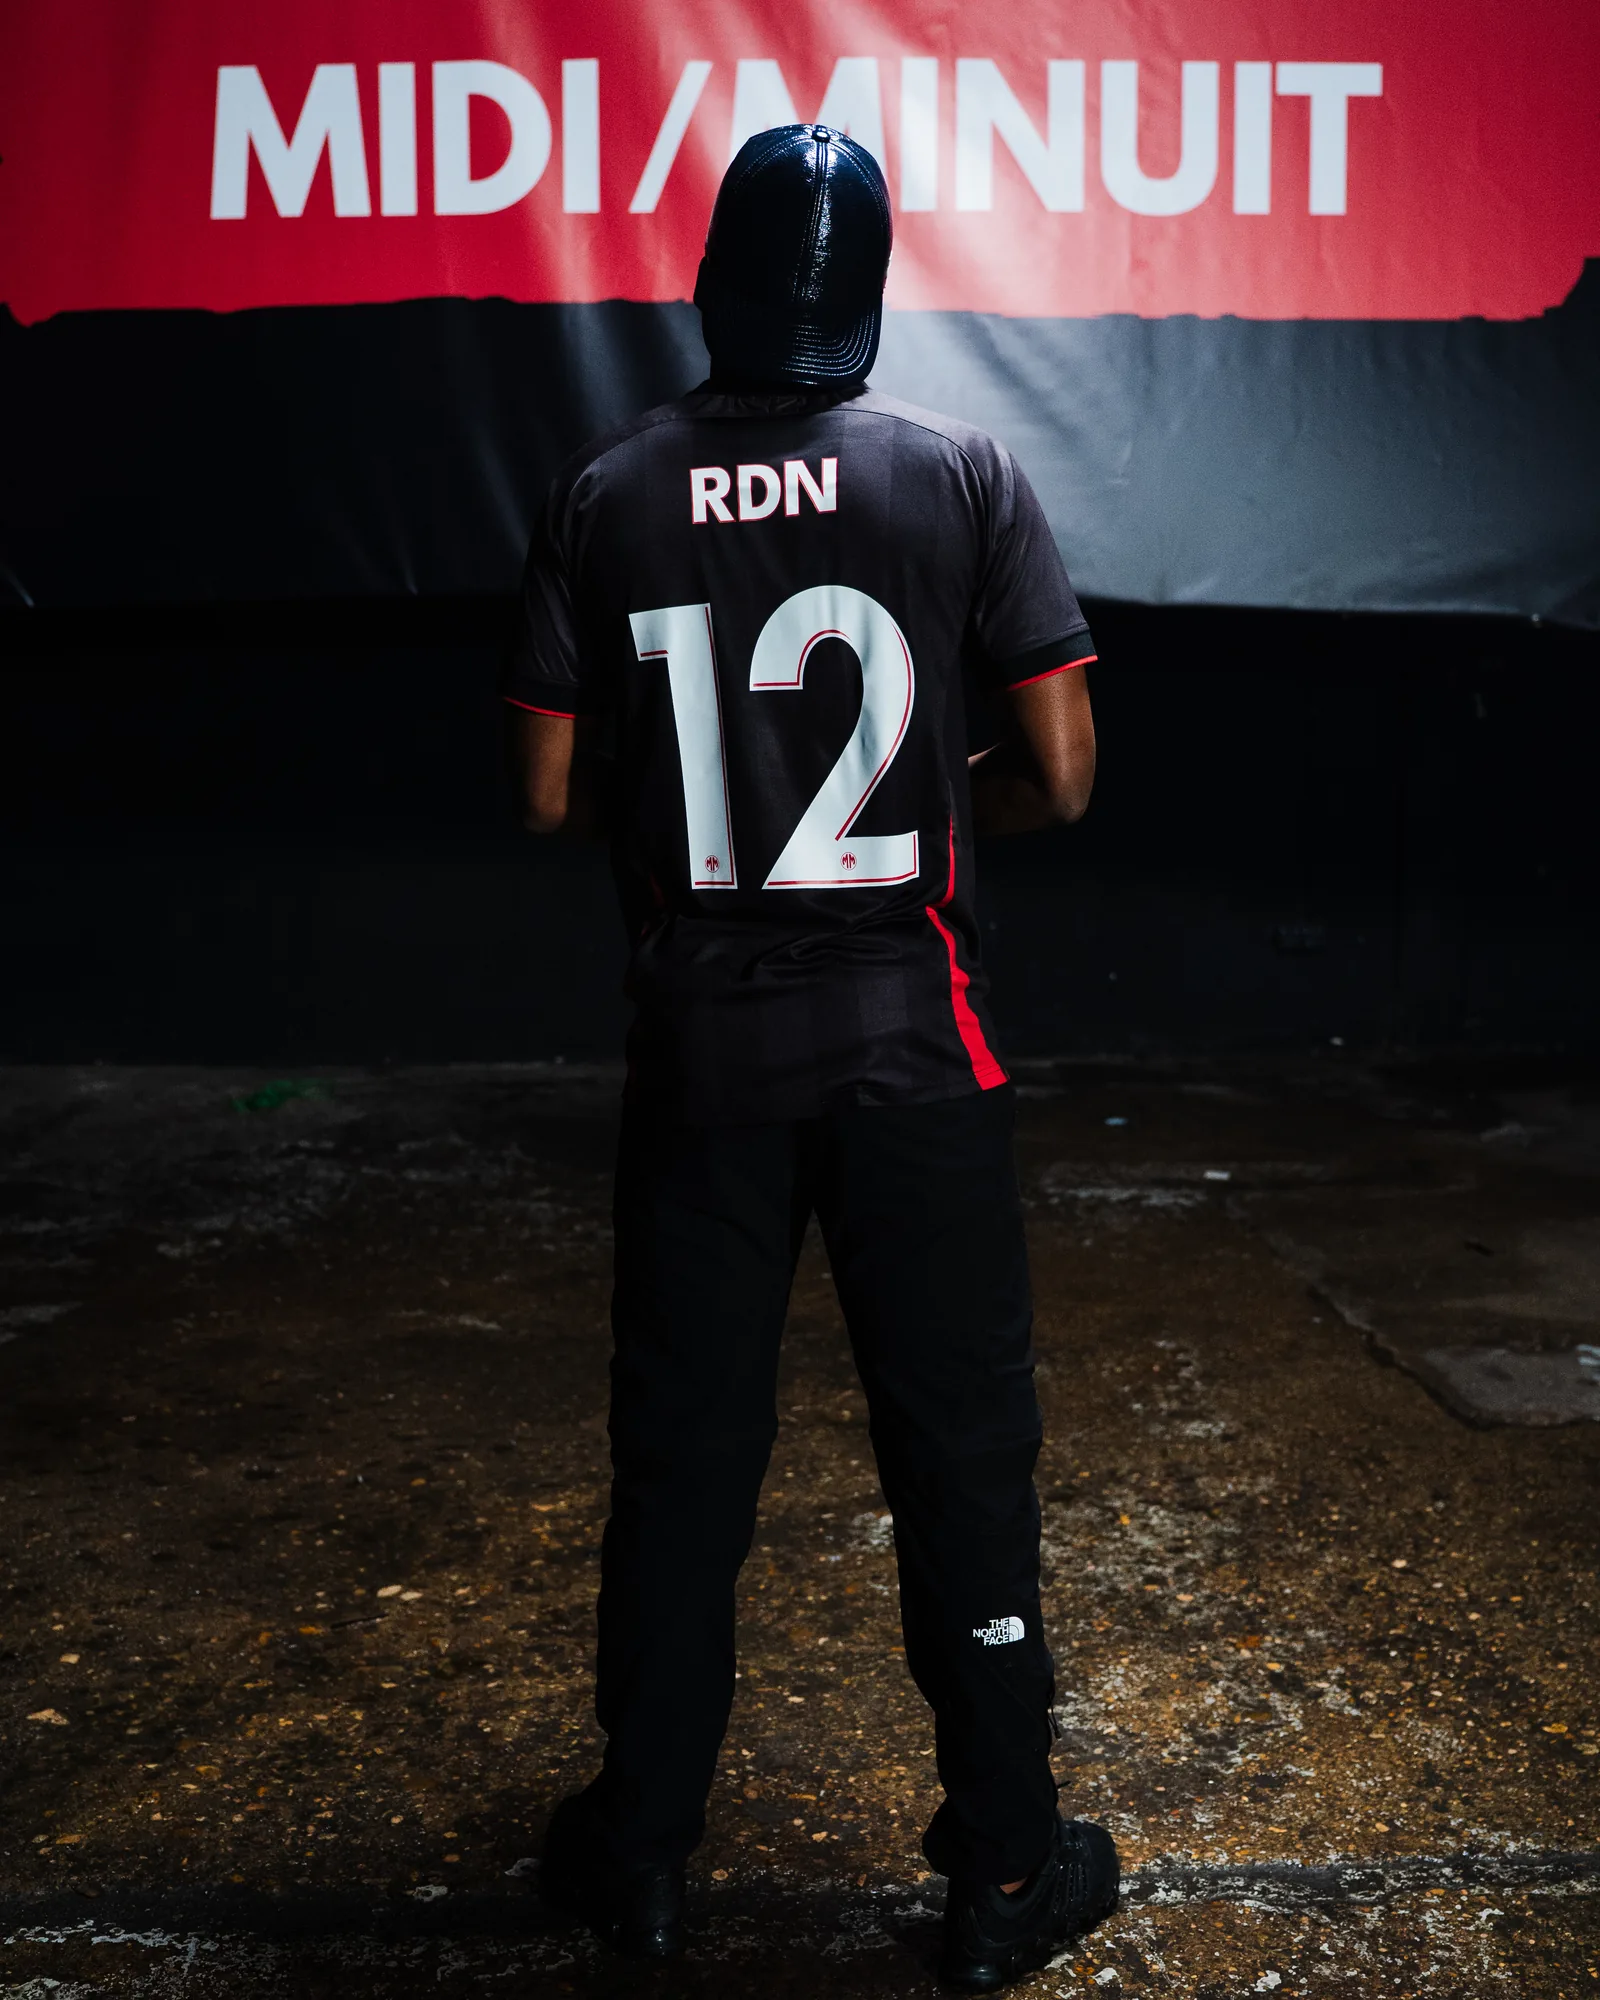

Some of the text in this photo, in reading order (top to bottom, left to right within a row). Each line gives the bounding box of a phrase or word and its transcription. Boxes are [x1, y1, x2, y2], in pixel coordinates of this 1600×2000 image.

[211, 58, 600, 220] MIDI
[690, 457, 838, 524] RDN
[629, 585, 919, 889] 12
[973, 1626, 1009, 1638] NORTH
[983, 1635, 1009, 1646] FACE
[989, 1617, 1009, 1629] THE
